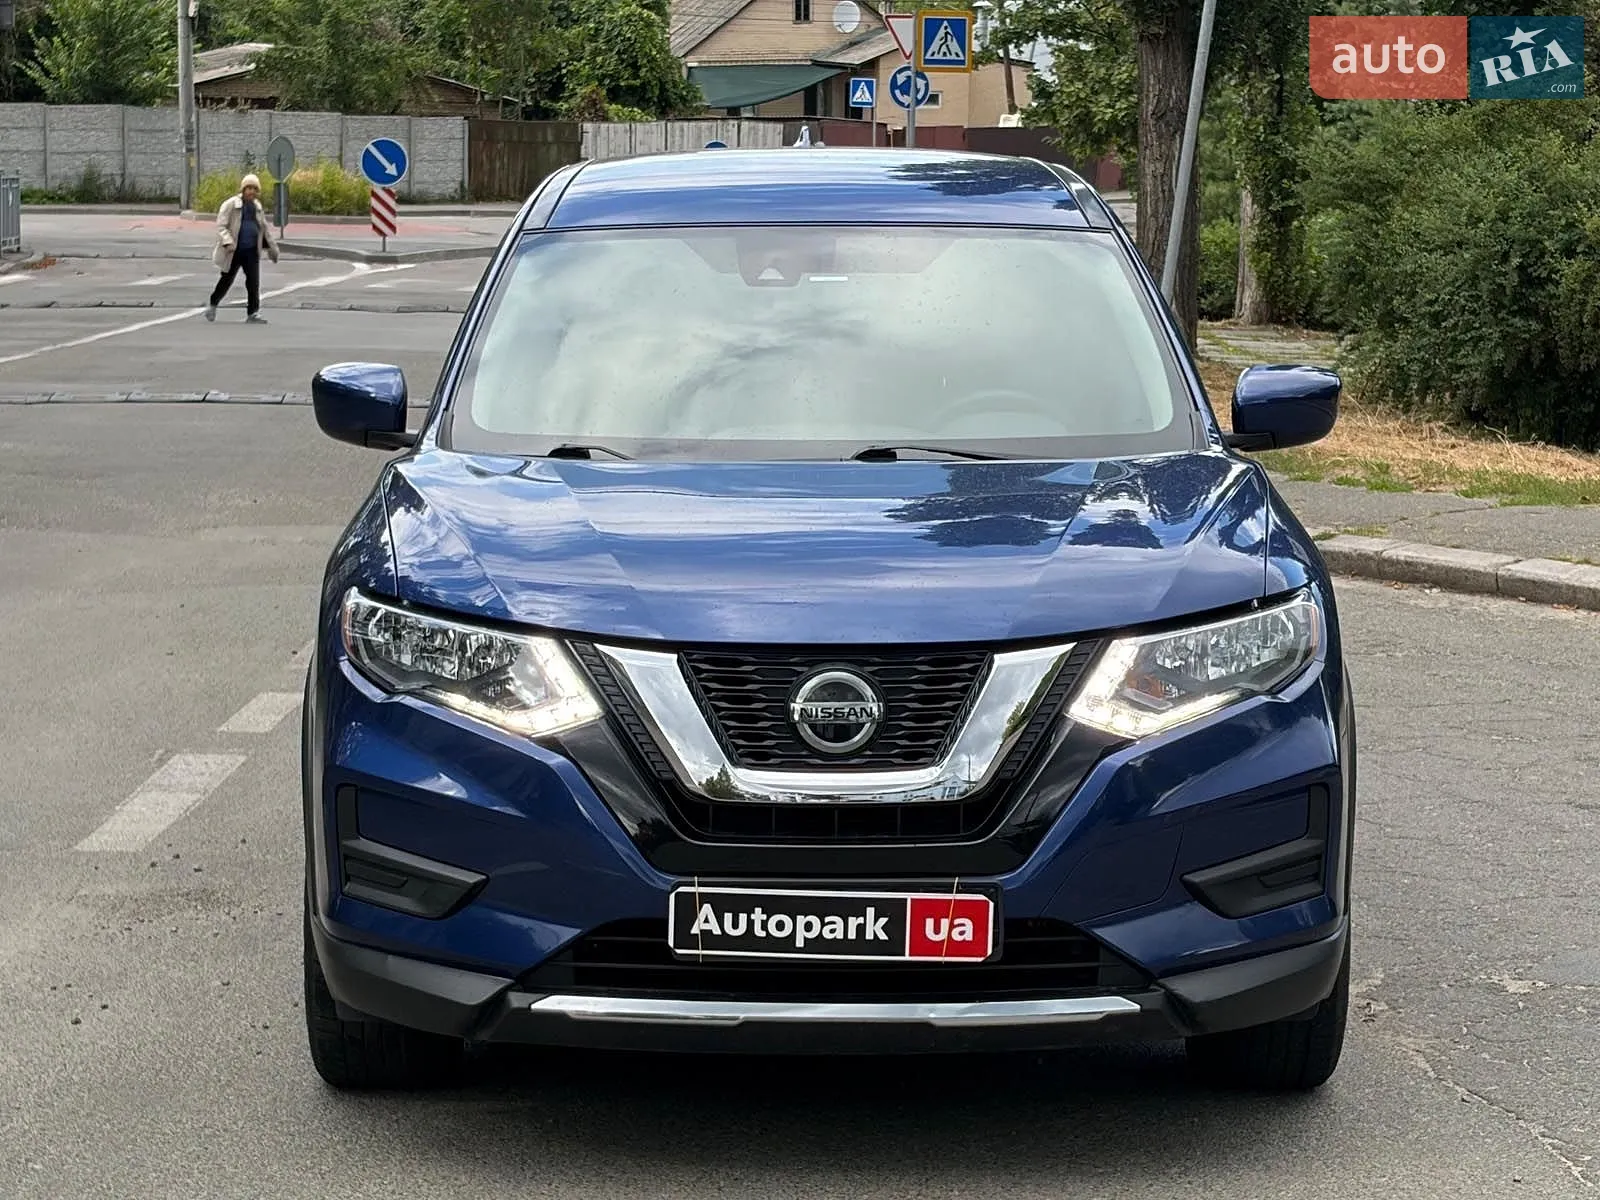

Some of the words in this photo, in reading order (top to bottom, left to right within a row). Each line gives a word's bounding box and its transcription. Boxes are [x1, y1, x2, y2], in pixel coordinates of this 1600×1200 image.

[800, 707, 873, 719] NISSAN
[690, 903, 889, 948] Autopark
[924, 917, 973, 941] ua
